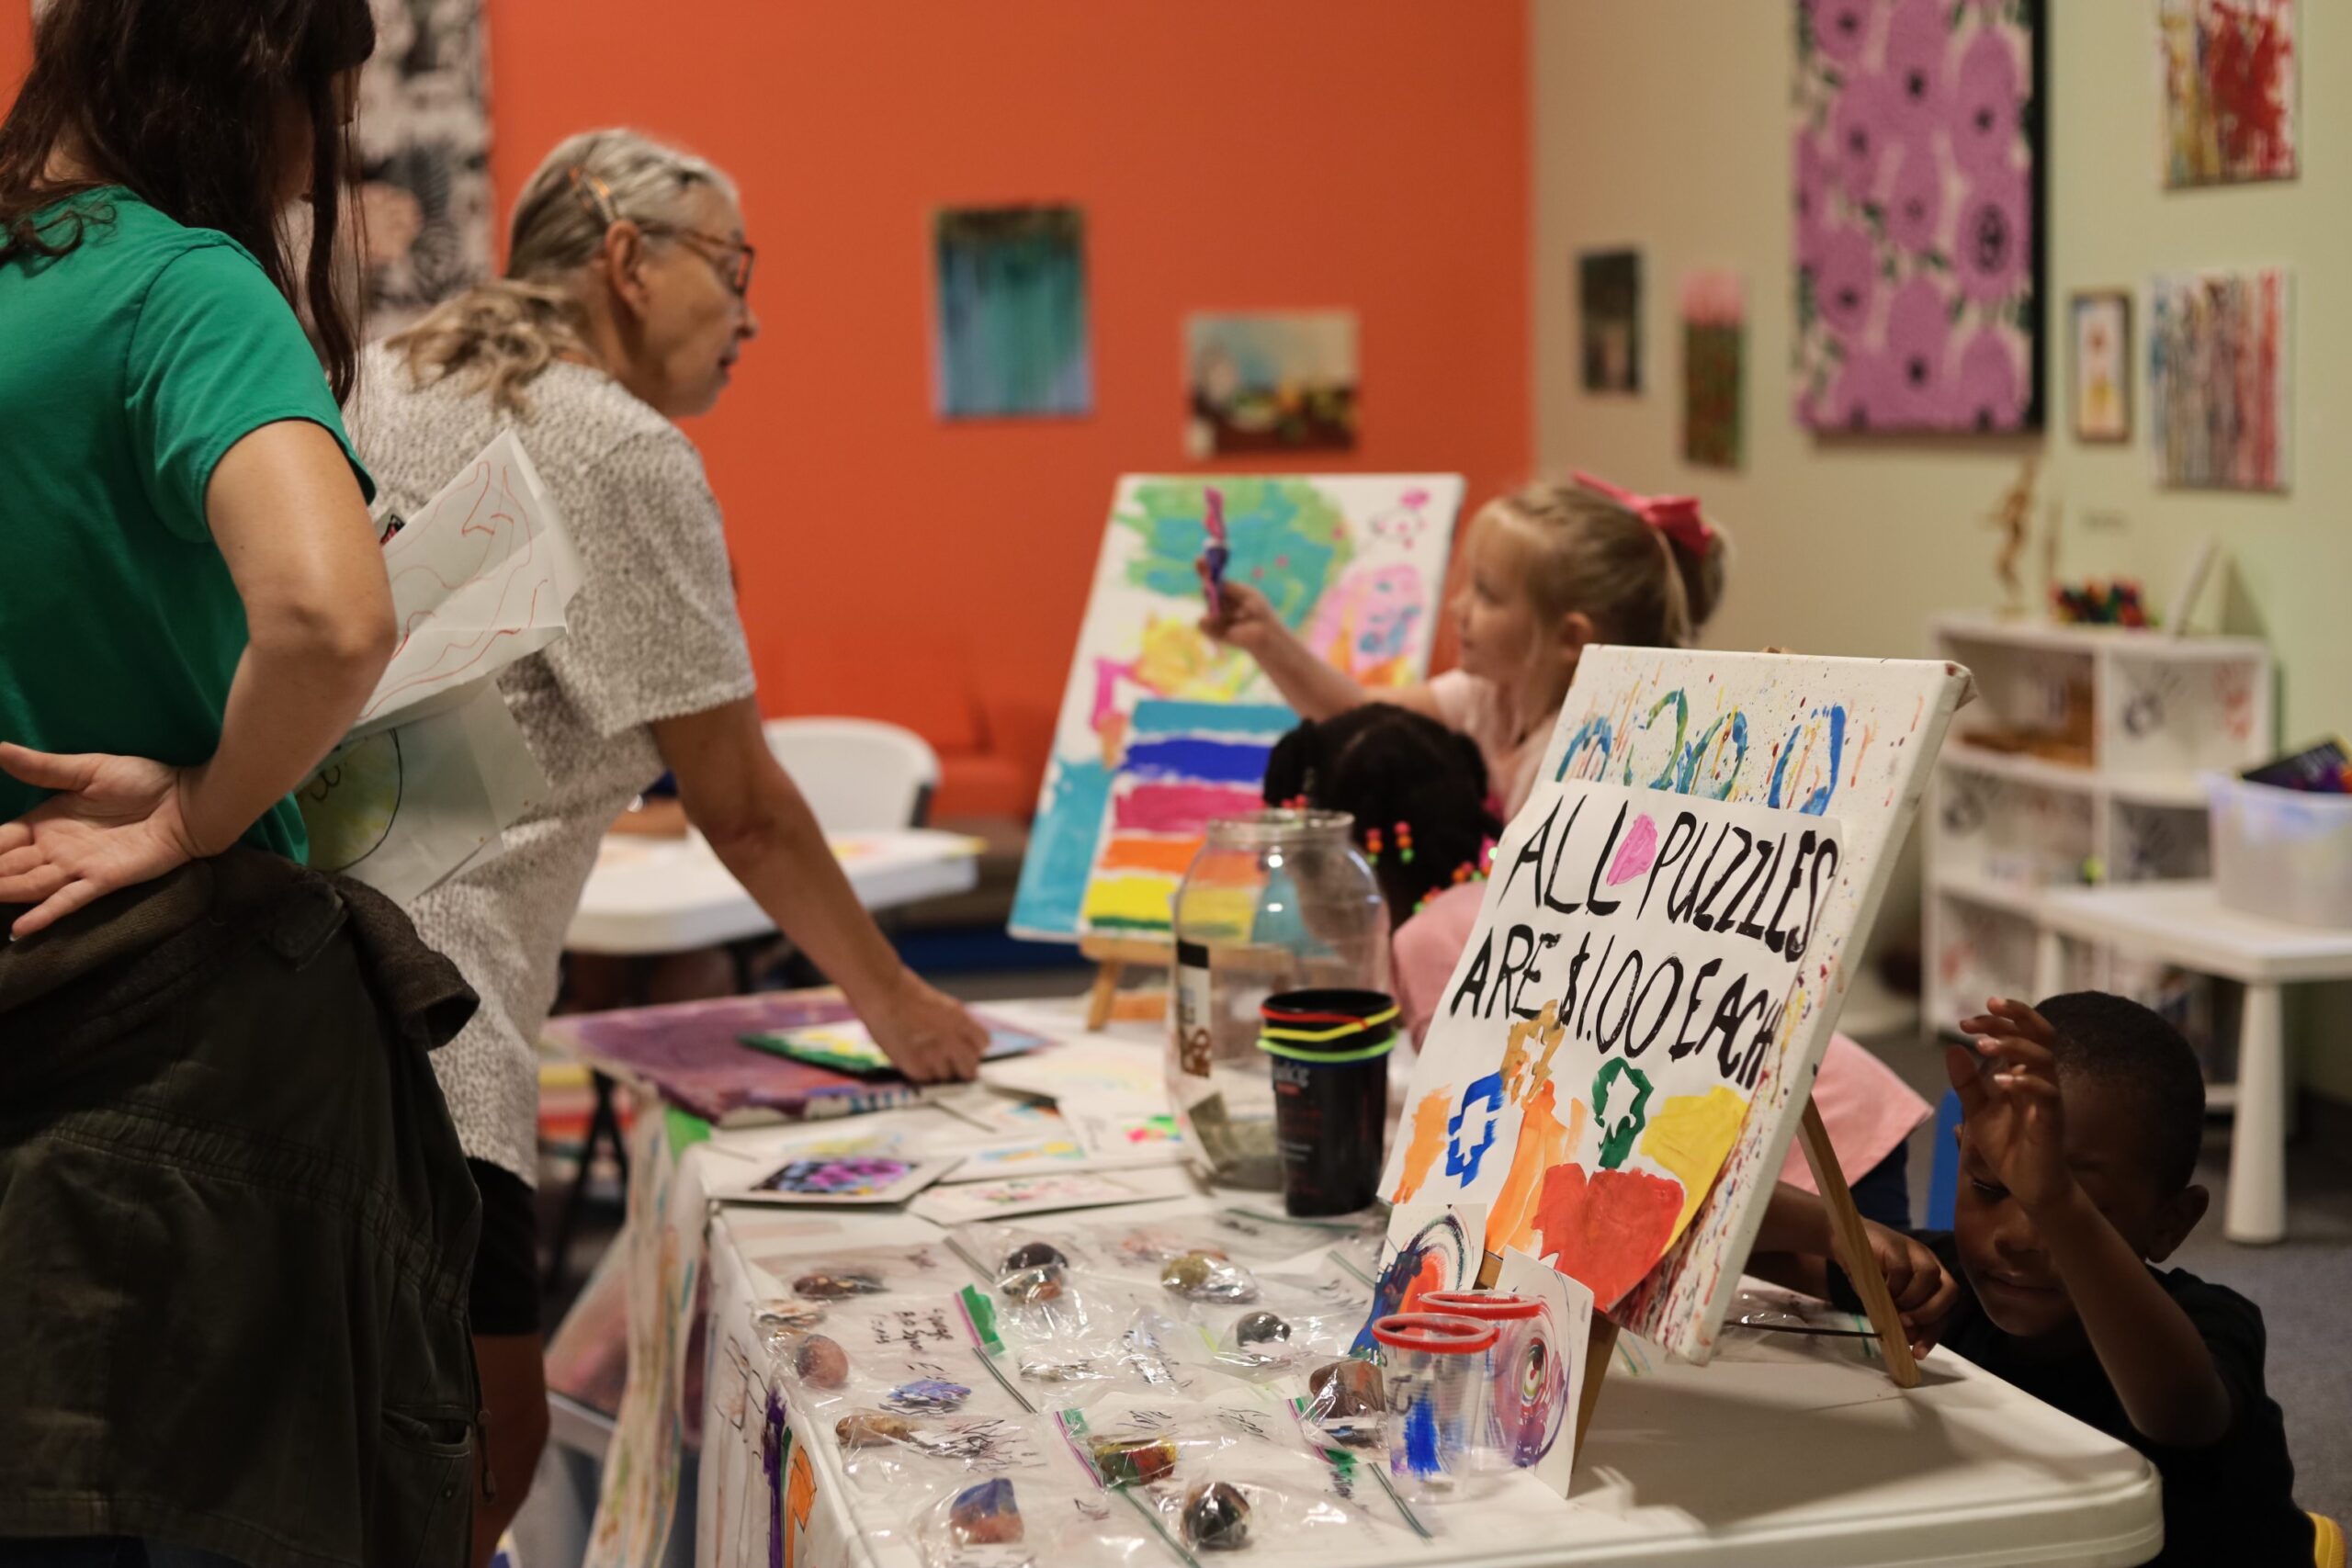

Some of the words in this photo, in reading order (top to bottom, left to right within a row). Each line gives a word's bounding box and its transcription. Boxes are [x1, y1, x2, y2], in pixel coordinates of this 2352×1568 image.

[1497, 795, 1629, 917] ALL
[1635, 811, 1838, 963] PUZZLES
[1449, 923, 1562, 1020] ARE
[1553, 931, 1684, 1058] $1.00
[1668, 958, 1782, 1090] EACH
